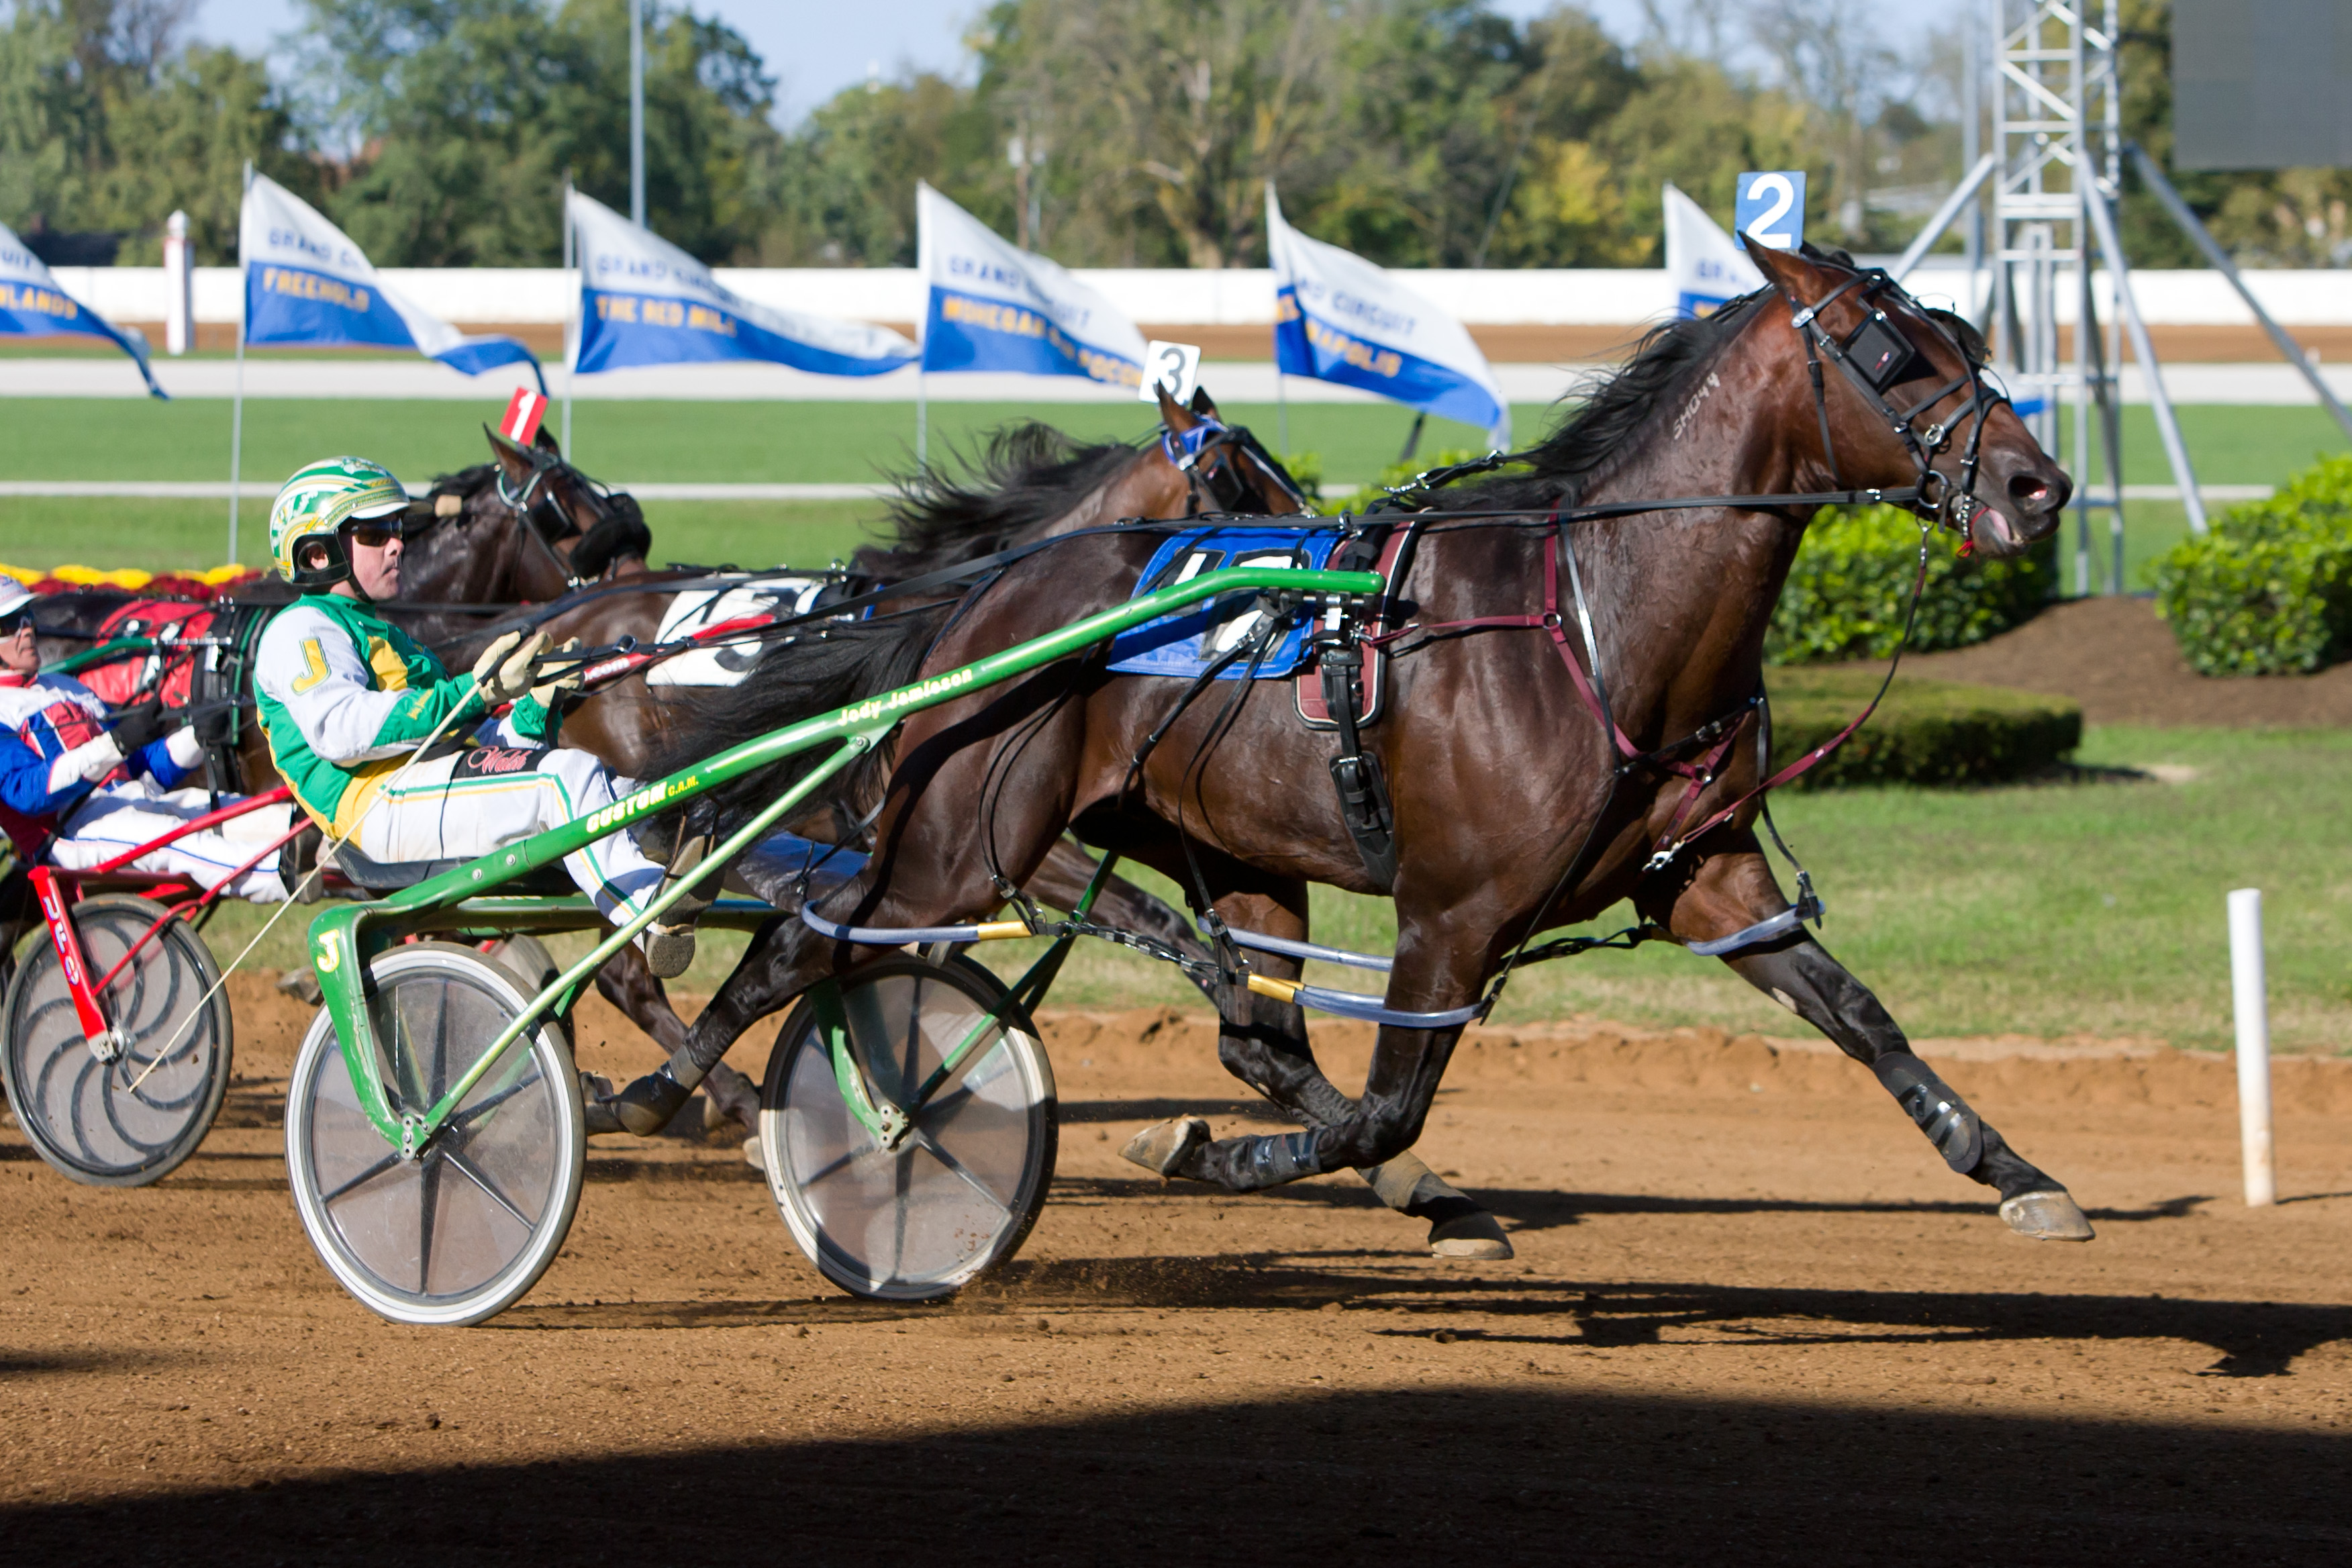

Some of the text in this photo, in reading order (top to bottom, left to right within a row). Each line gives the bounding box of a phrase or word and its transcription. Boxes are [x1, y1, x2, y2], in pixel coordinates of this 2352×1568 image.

[1747, 173, 1794, 248] 2
[264, 267, 369, 313] FREEHOLD
[596, 295, 637, 322] THE
[642, 299, 684, 328] RED
[1153, 347, 1186, 397] 3
[509, 390, 538, 442] 1
[291, 637, 332, 696] J
[837, 668, 973, 727] Jody Jamieson
[586, 781, 668, 834] CUSTOM
[317, 928, 340, 973] J
